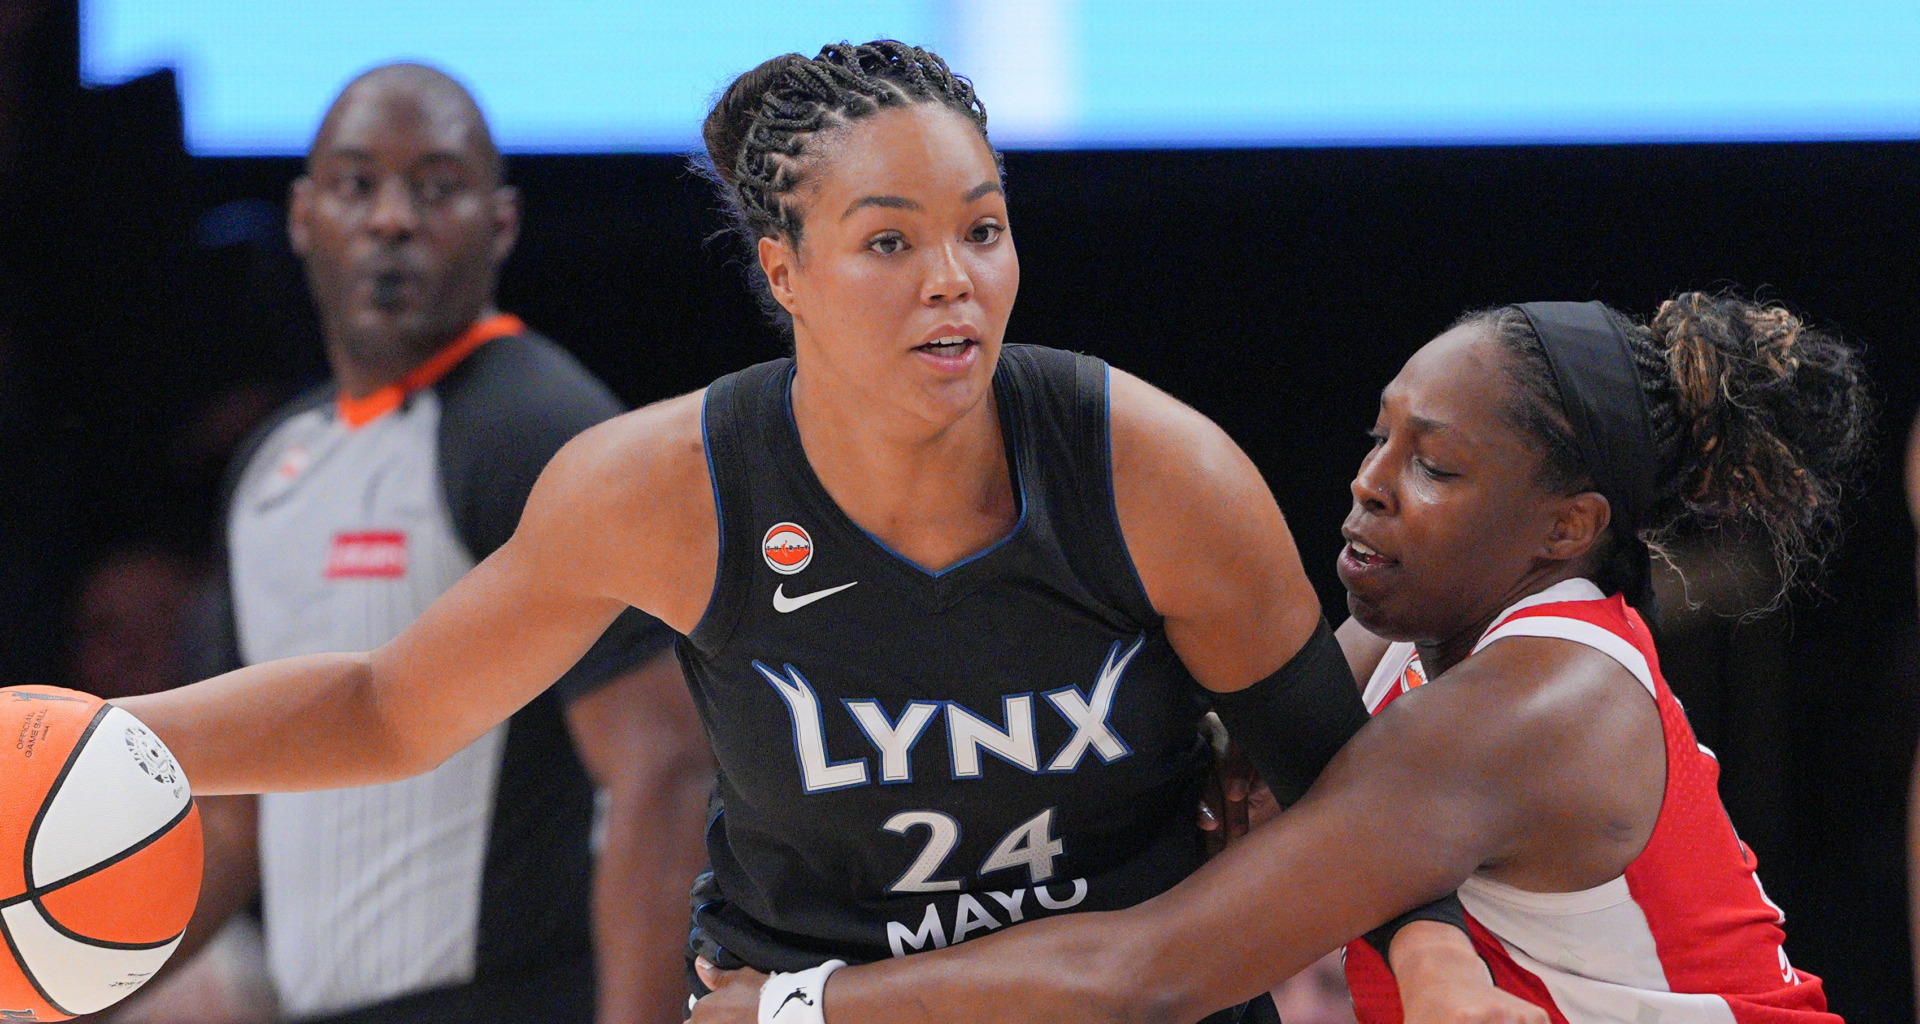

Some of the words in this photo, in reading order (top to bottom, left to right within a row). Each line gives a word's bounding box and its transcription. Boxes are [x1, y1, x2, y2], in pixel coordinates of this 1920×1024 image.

[17, 712, 35, 750] OFFICIAL
[26, 730, 39, 758] GAME
[34, 709, 48, 730] BALL
[752, 632, 1147, 795] LYNX
[882, 808, 1065, 894] 24
